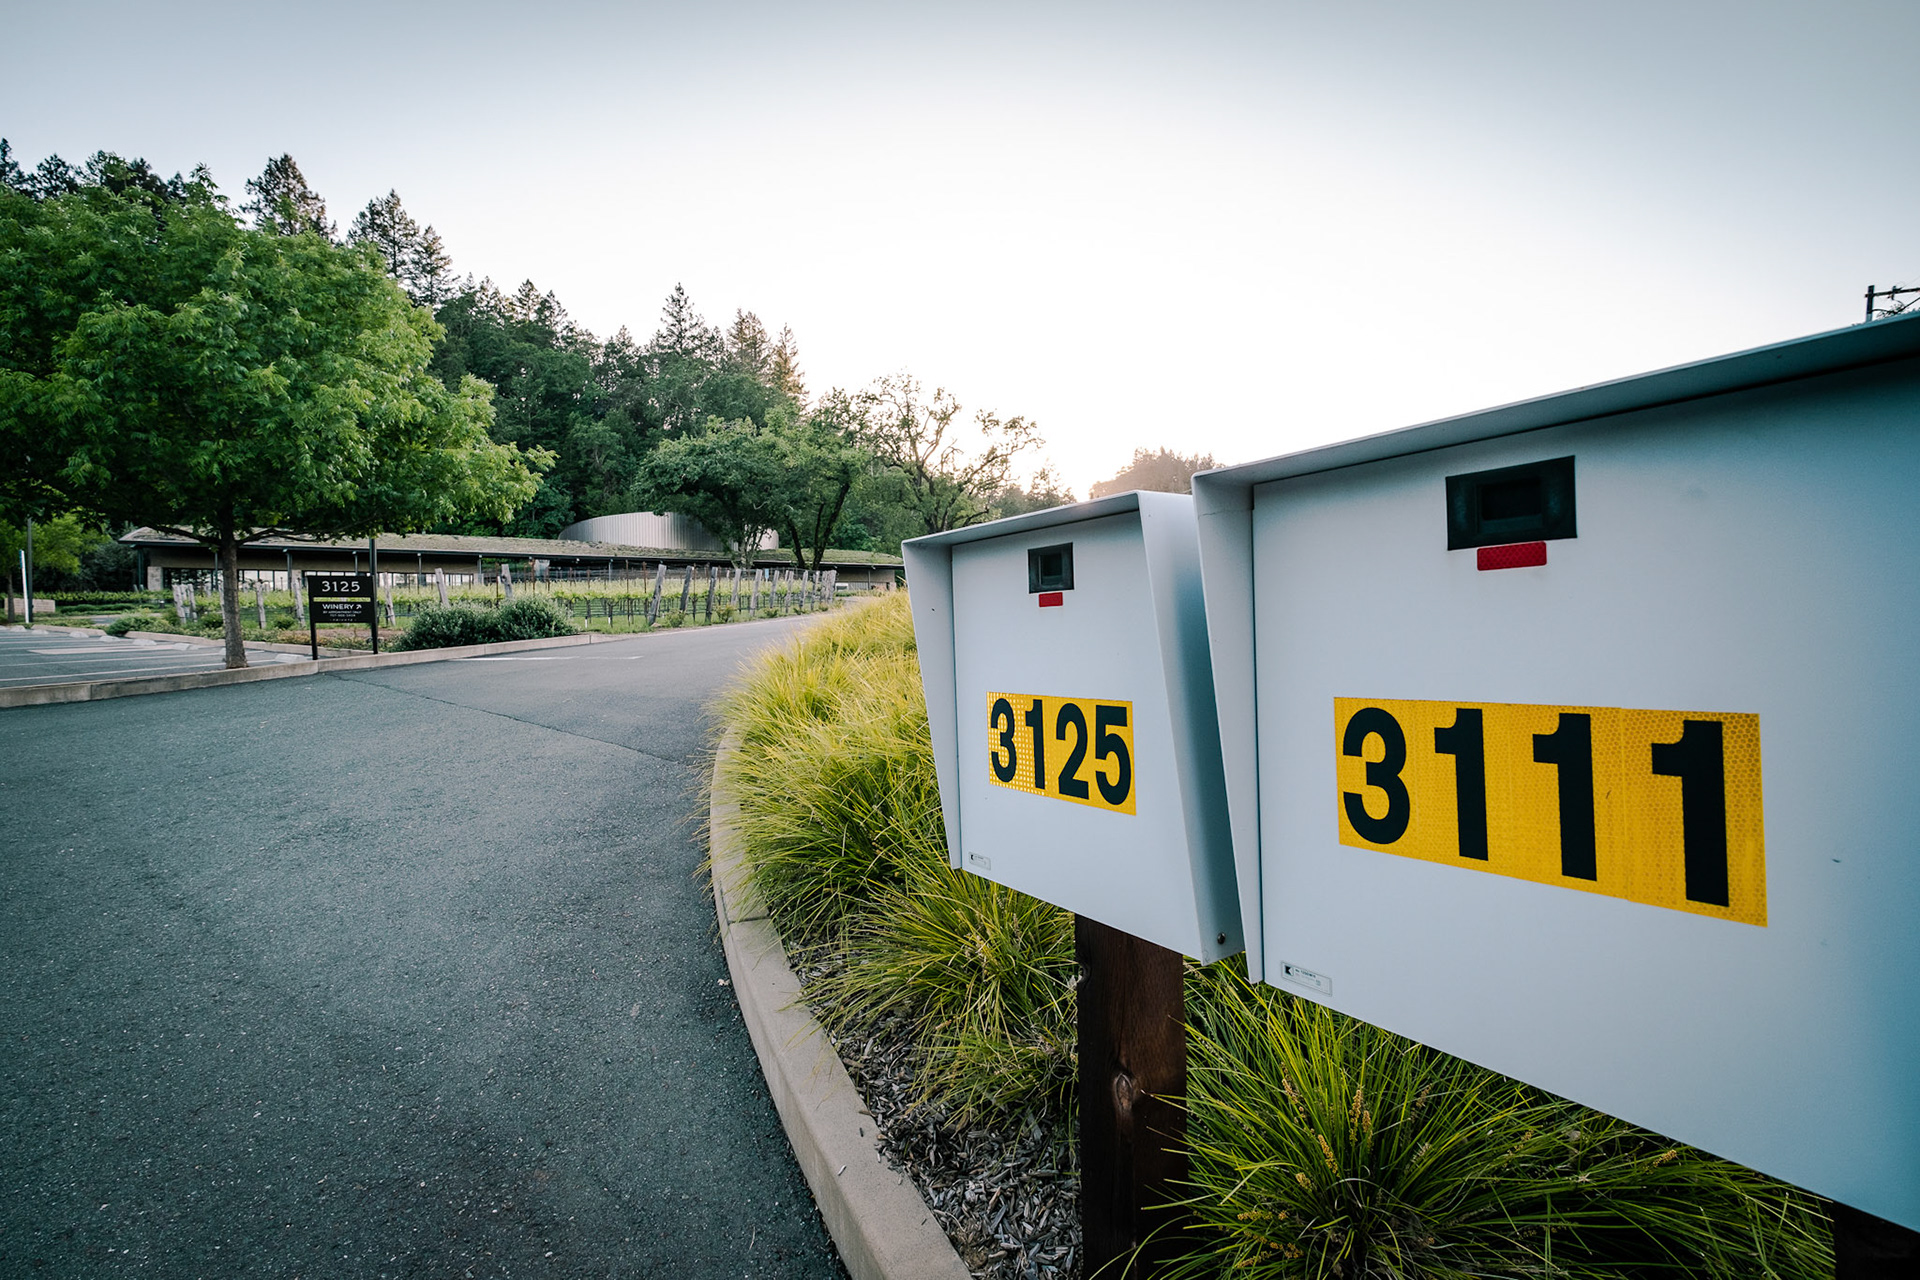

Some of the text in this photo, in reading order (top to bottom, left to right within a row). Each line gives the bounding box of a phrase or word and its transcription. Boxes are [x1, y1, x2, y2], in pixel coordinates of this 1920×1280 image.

[321, 580, 361, 592] 3125
[990, 697, 1131, 806] 3125
[1342, 706, 1729, 908] 3111
